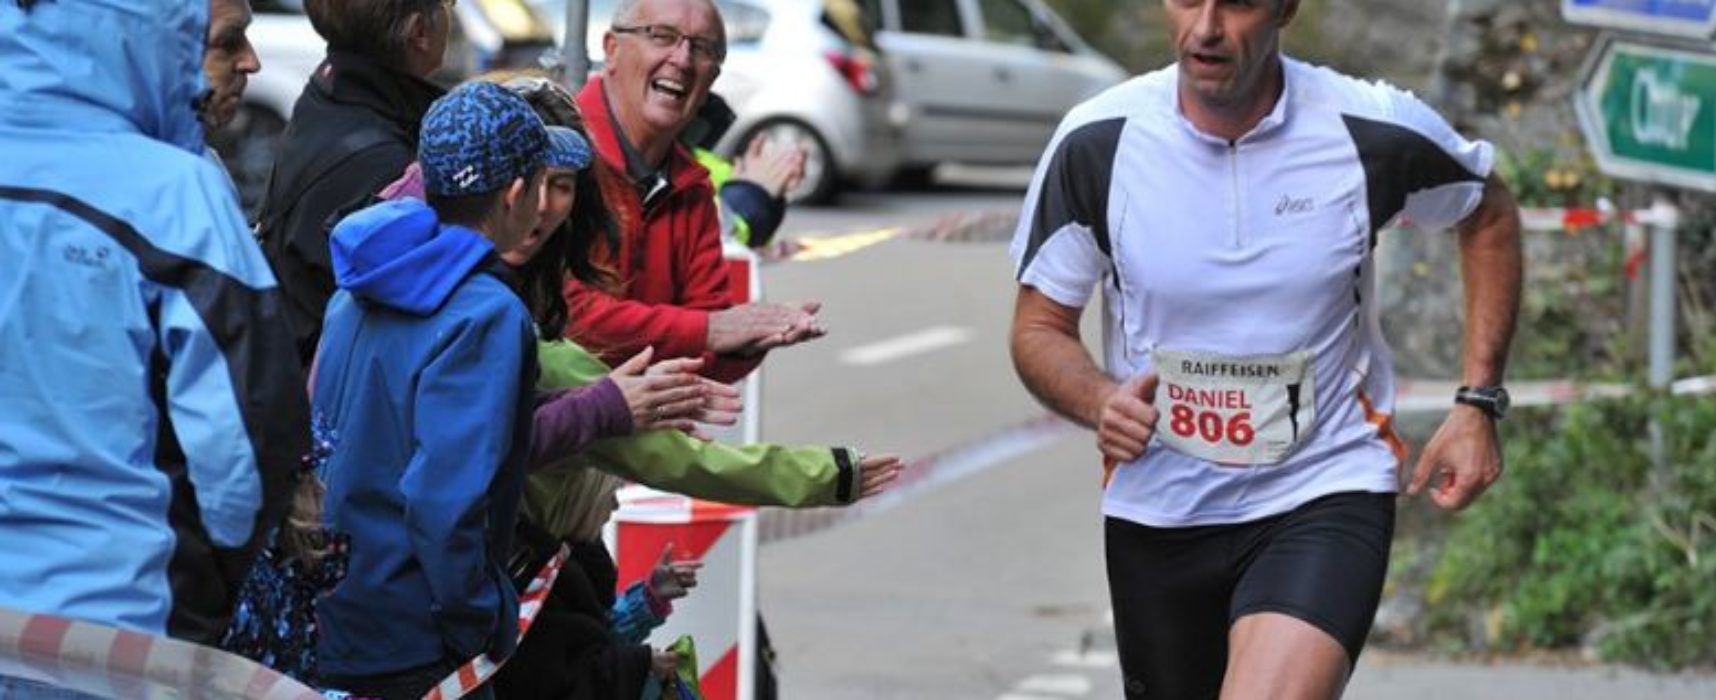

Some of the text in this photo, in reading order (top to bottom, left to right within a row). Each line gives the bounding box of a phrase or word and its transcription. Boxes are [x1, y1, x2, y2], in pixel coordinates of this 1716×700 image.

[1181, 360, 1280, 377] RAIFFEISEN
[1168, 384, 1252, 409] DANIEL
[1170, 404, 1255, 446] 806
